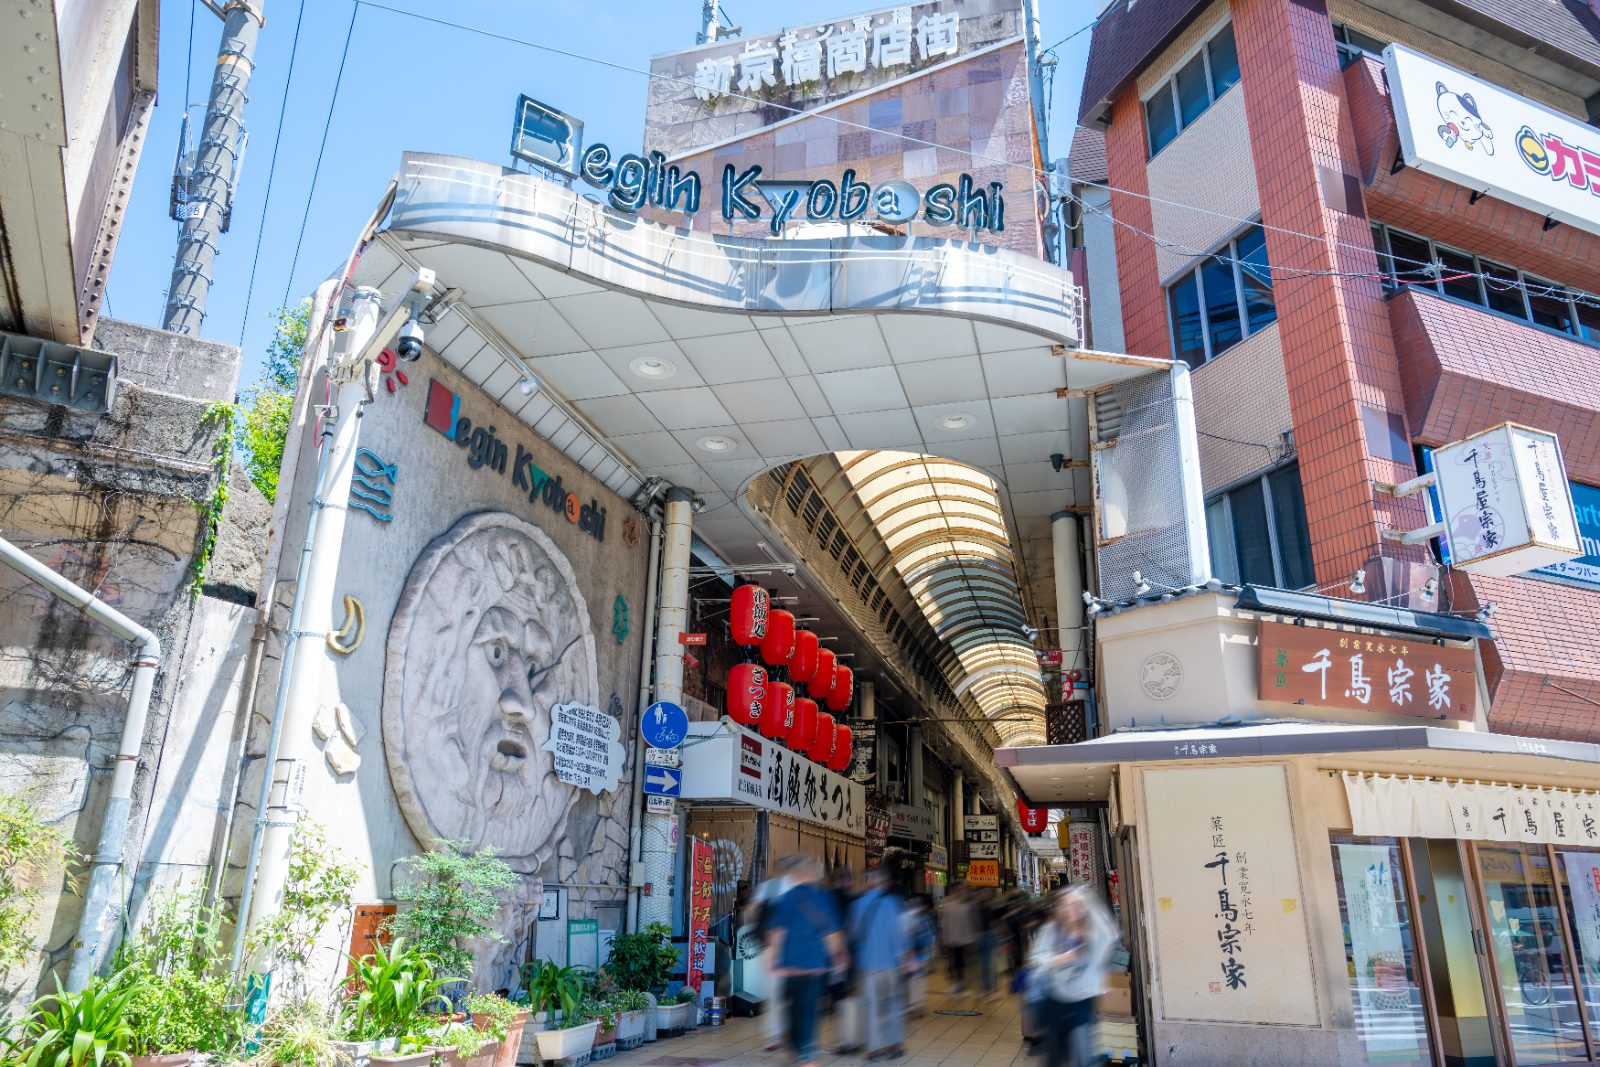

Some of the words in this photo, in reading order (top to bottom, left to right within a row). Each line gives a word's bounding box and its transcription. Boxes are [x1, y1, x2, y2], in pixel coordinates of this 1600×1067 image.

[694, 11, 960, 101] 新京橋商店街
[510, 93, 701, 214] Begin
[721, 162, 1005, 236] Kyobashi
[424, 378, 508, 474] Begin
[511, 444, 606, 542] Kyobashi
[1464, 448, 1499, 549] 千鳥屋宗家
[751, 587, 768, 639] 酒飯処
[750, 668, 765, 718] さつき
[1301, 648, 1451, 710] 千鳥宗家
[1180, 743, 1218, 756] 千鳥宗家
[767, 747, 854, 829] 酒飯処さつき
[1210, 816, 1226, 849] 菓匠
[693, 928, 706, 973] 大歓迎
[1204, 852, 1248, 990] 千鳥宗家
